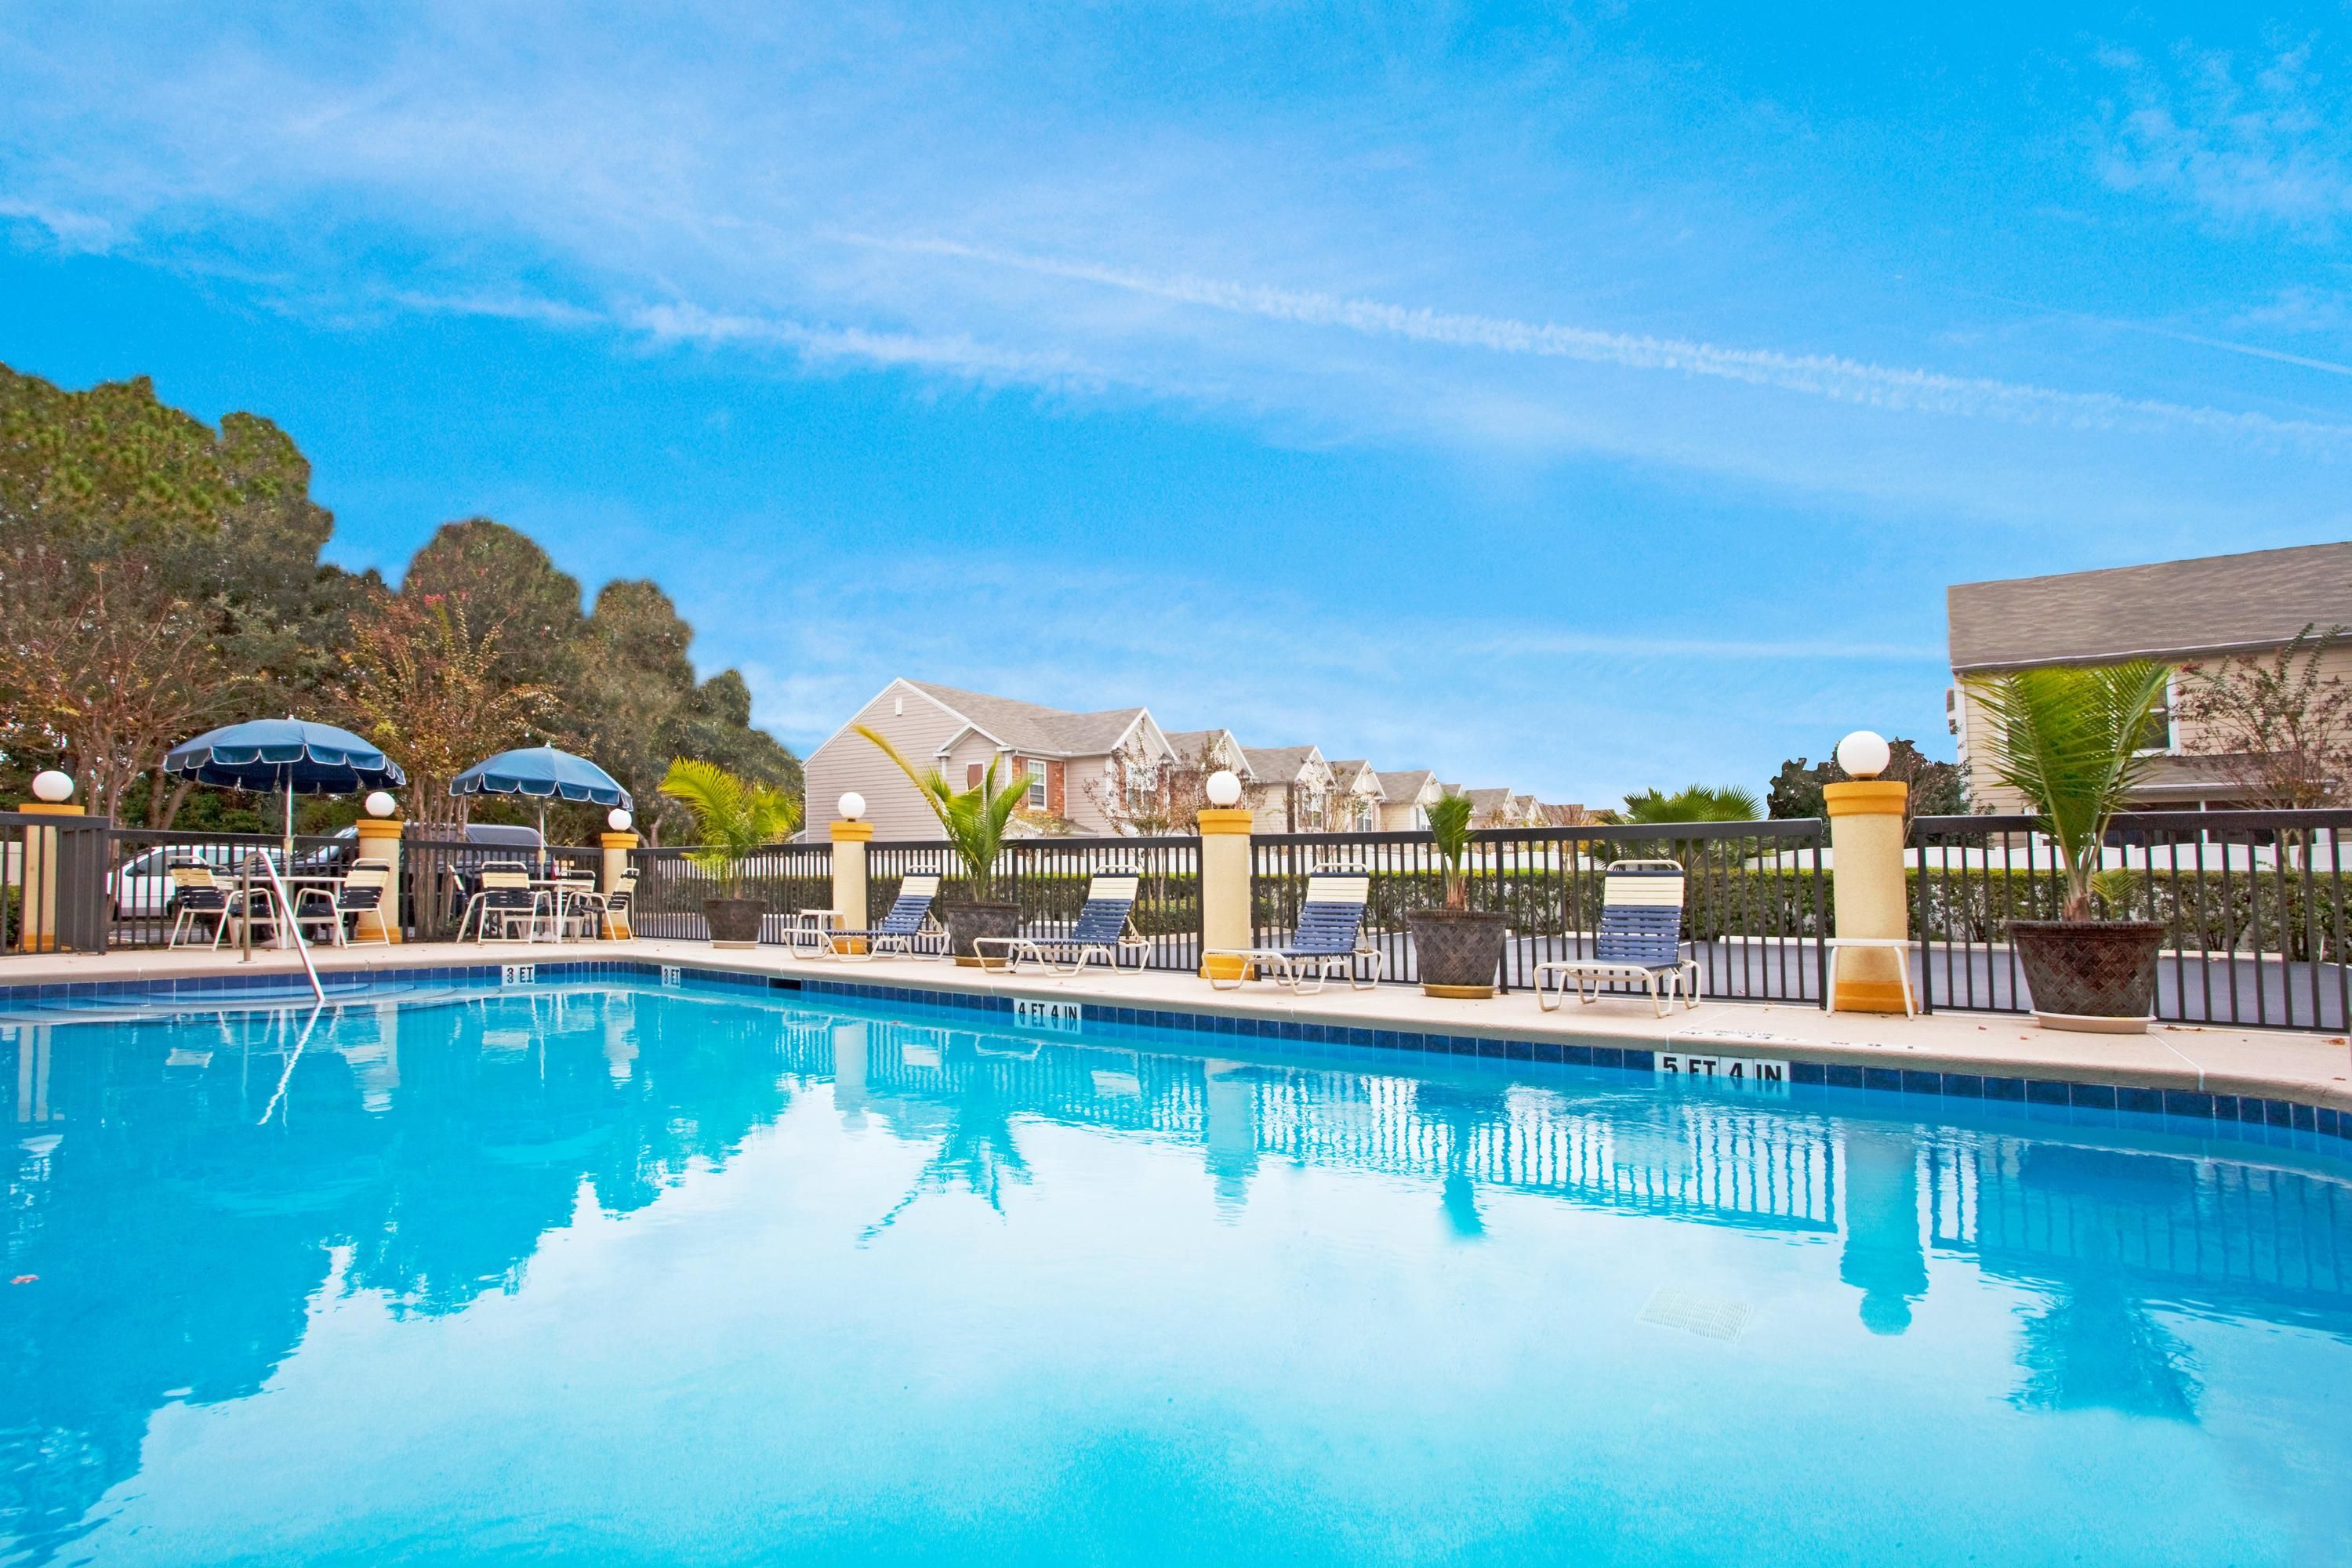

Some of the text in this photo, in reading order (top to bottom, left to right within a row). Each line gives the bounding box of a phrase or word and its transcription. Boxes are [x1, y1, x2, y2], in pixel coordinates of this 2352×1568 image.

[506, 967, 514, 978] 3
[1018, 1002, 1078, 1019] 4 FT 4 IN
[1663, 1056, 1782, 1081] 5 FT 4 IN
